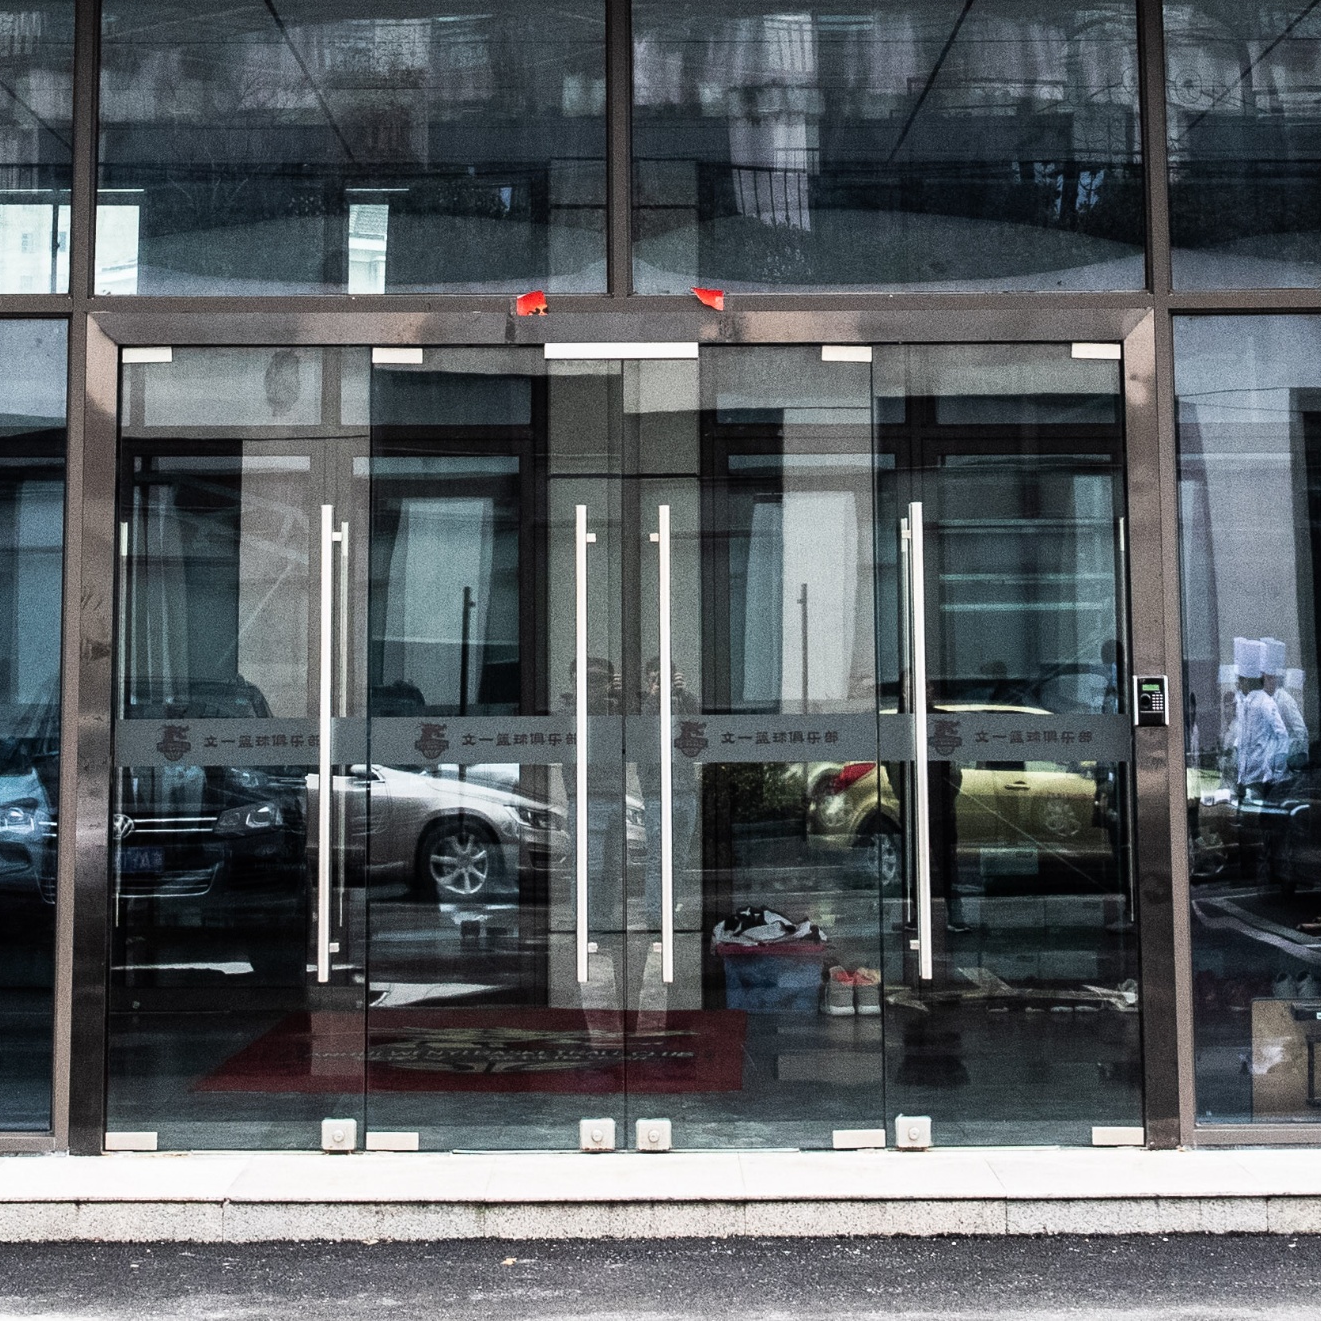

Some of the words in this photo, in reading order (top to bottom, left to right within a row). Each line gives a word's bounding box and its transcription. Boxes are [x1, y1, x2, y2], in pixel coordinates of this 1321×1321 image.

[720, 731, 839, 745] 文一篮球俱乐部
[975, 729, 1093, 744] 文一篮球俱乐部
